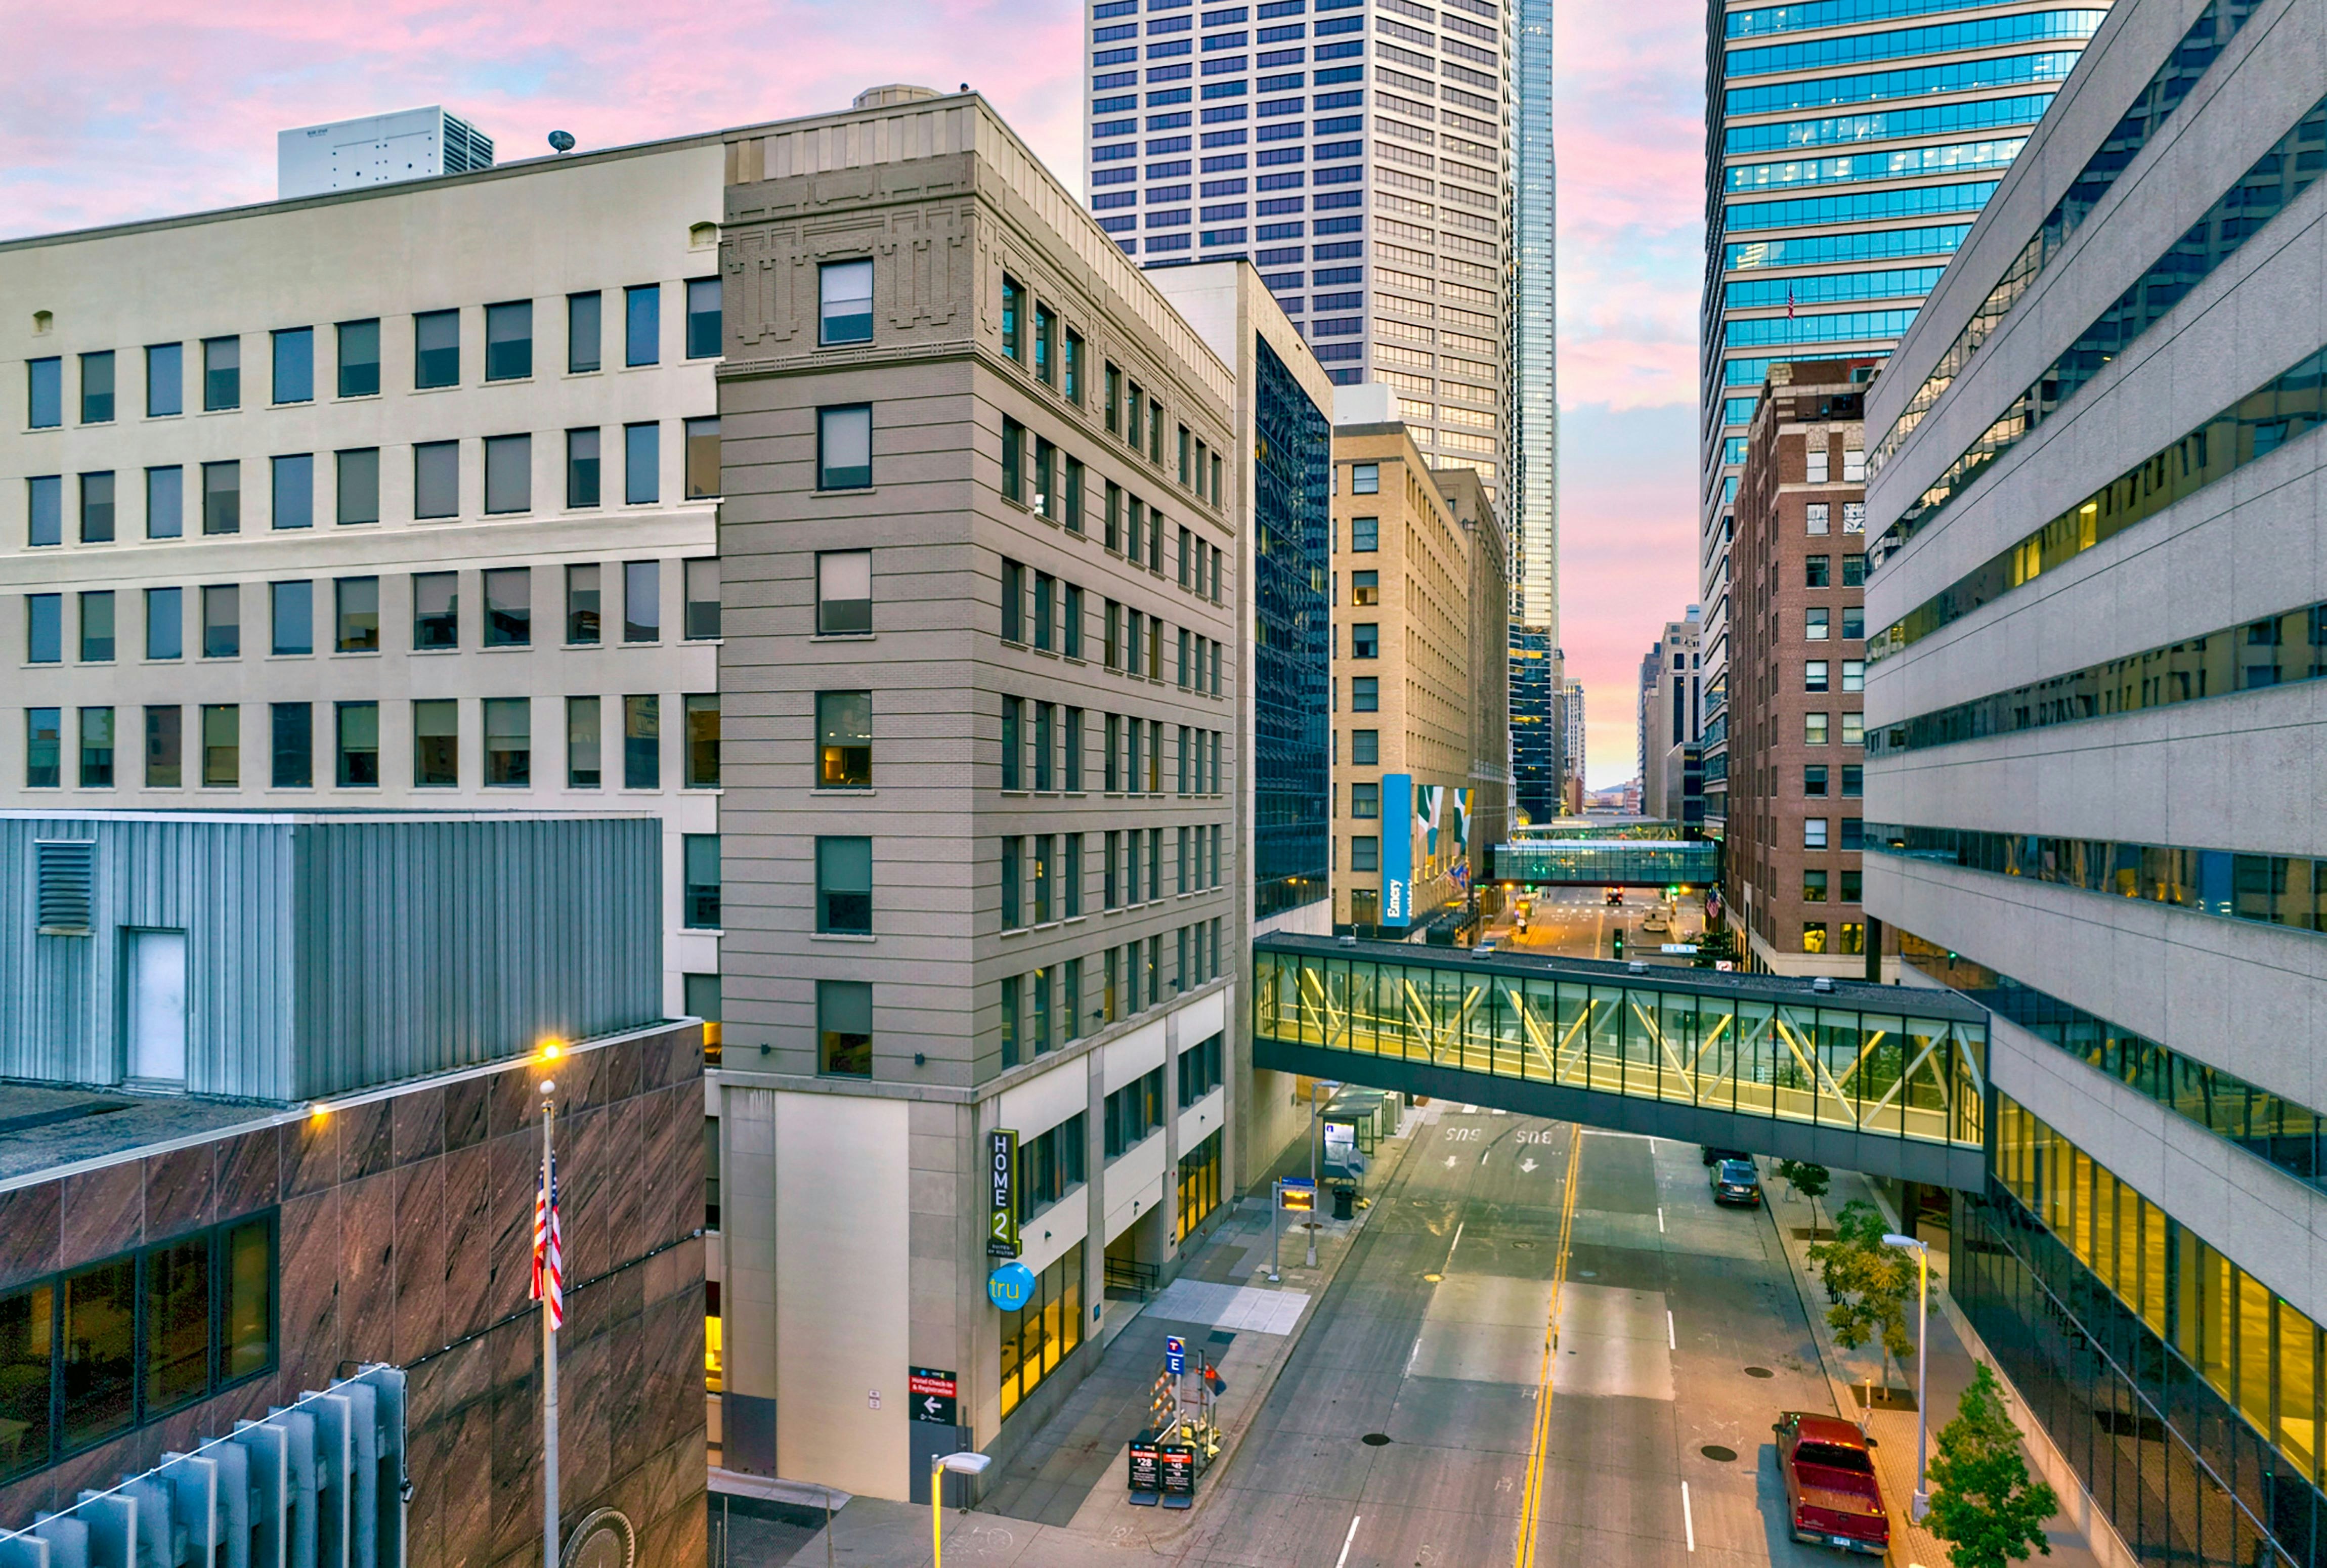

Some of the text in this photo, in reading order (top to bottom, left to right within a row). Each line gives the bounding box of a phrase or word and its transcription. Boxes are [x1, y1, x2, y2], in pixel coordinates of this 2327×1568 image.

[1388, 879, 1403, 917] Emery
[1445, 1127, 1481, 1142] BUS
[994, 1136, 1008, 1239] HOME 2
[989, 1278, 1019, 1299] tru
[1172, 1359, 1180, 1371] E
[912, 1377, 928, 1385] Hotel
[918, 1384, 953, 1395] Registration
